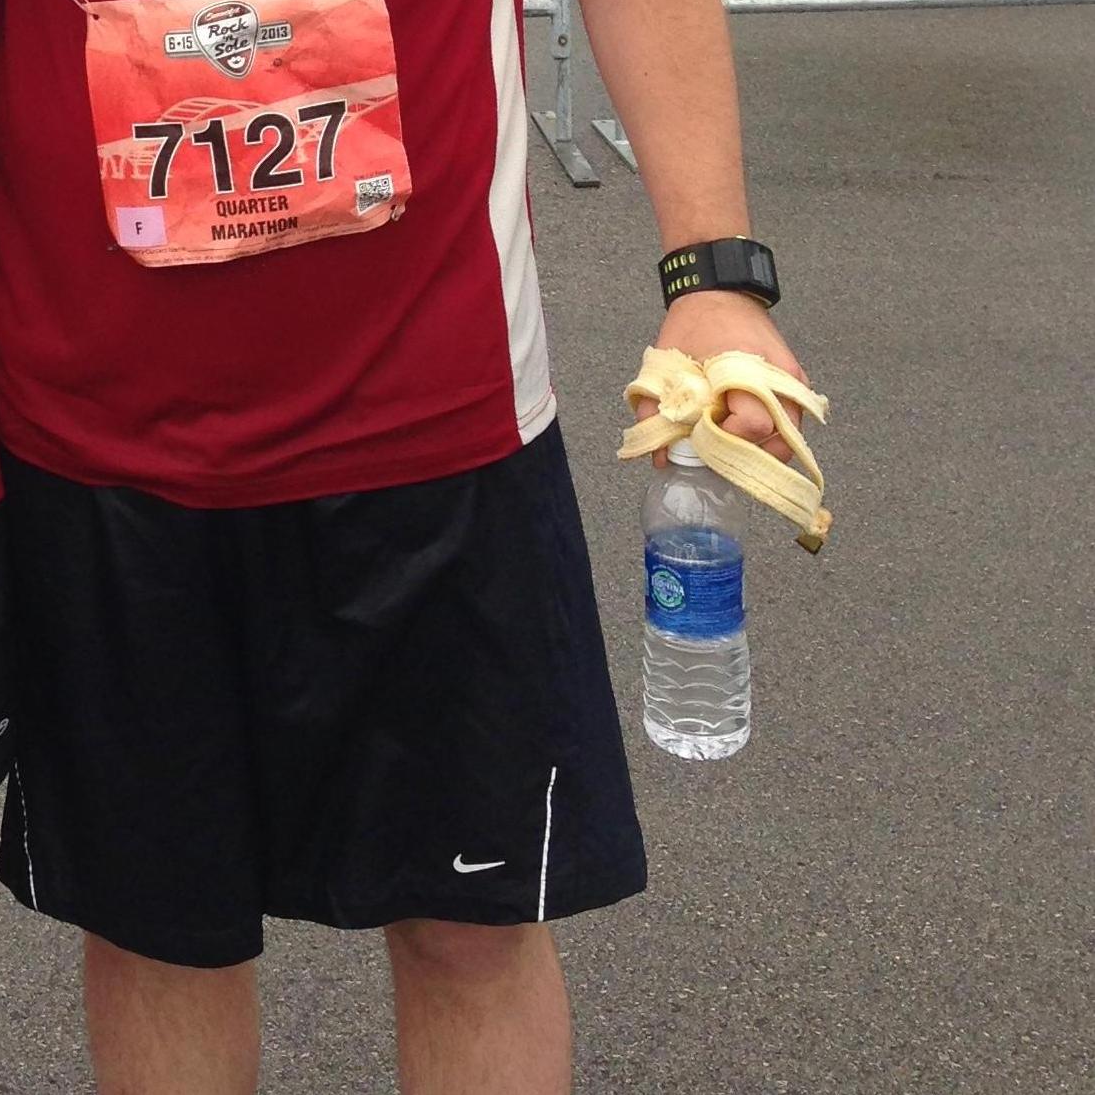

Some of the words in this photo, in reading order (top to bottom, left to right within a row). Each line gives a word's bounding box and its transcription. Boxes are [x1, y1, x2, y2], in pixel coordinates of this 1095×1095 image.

[207, 18, 249, 39] Rock
[261, 25, 288, 41] 2013
[214, 38, 251, 57] Sole
[132, 99, 348, 200] 7127
[216, 195, 290, 218] QUARTER
[134, 222, 144, 235] F
[211, 216, 299, 241] MARATHON
